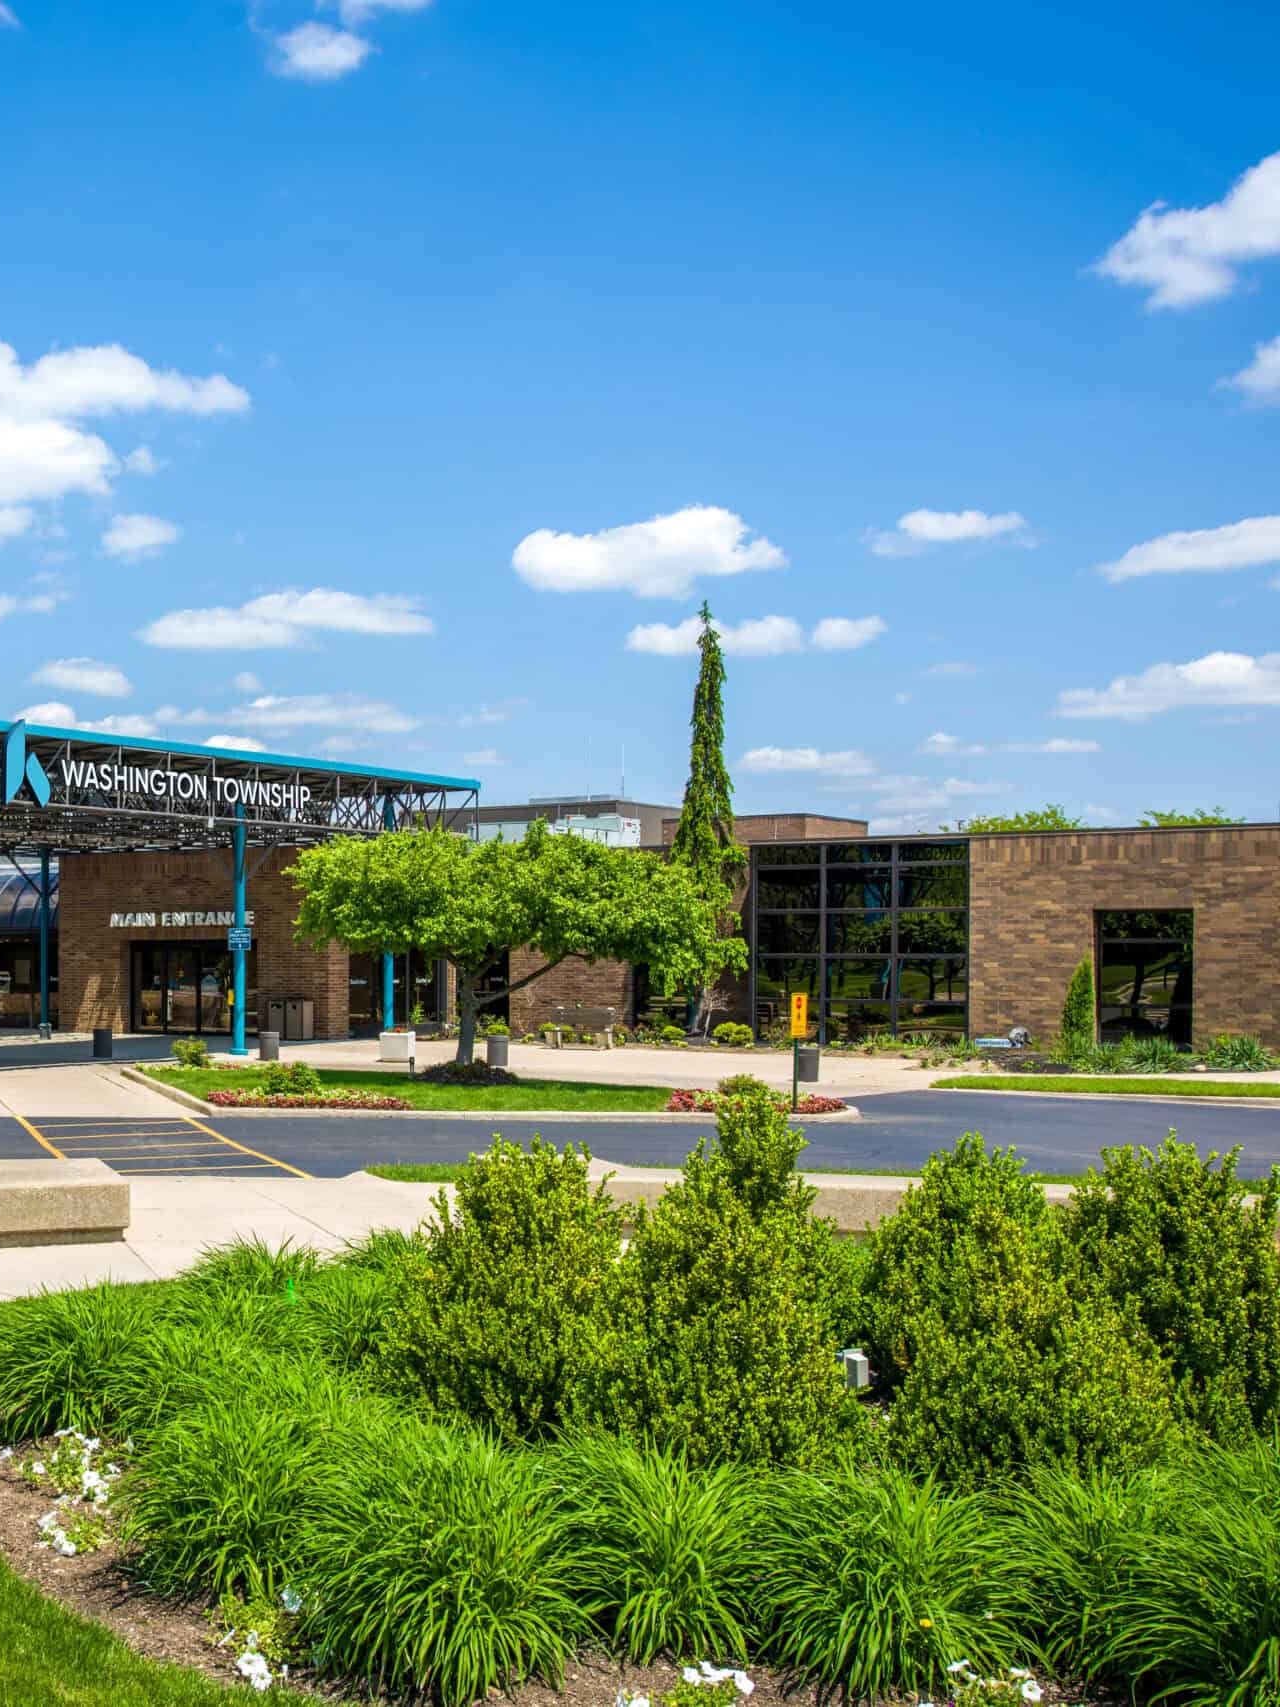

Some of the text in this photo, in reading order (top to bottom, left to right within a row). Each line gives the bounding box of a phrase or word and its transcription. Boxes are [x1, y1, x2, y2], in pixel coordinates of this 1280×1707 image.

[61, 759, 312, 810] WASHINGTON TOWNSHIP
[109, 912, 156, 928] MAIN
